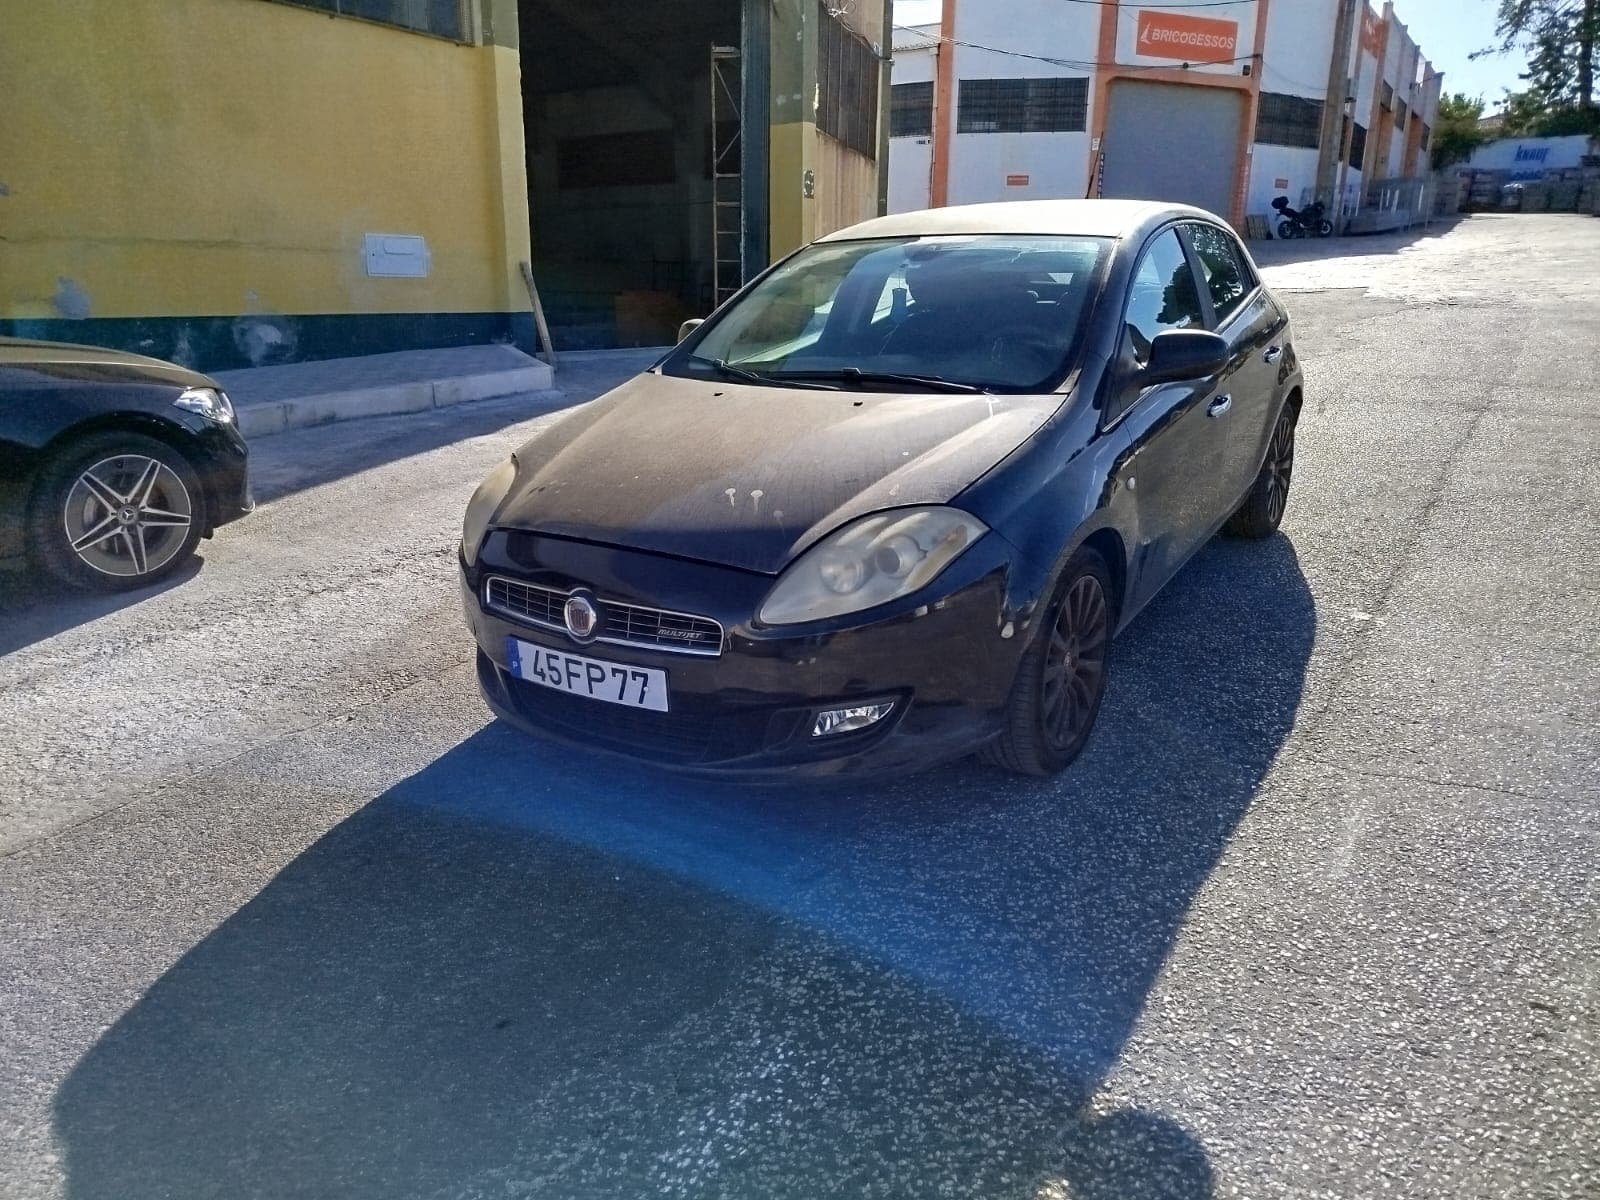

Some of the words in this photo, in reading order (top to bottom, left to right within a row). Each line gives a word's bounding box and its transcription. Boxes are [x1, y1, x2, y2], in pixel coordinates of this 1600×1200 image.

[1152, 28, 1234, 49] BRICOGESSOS
[658, 629, 702, 639] MULTIJET
[533, 650, 649, 704] 45FP77
